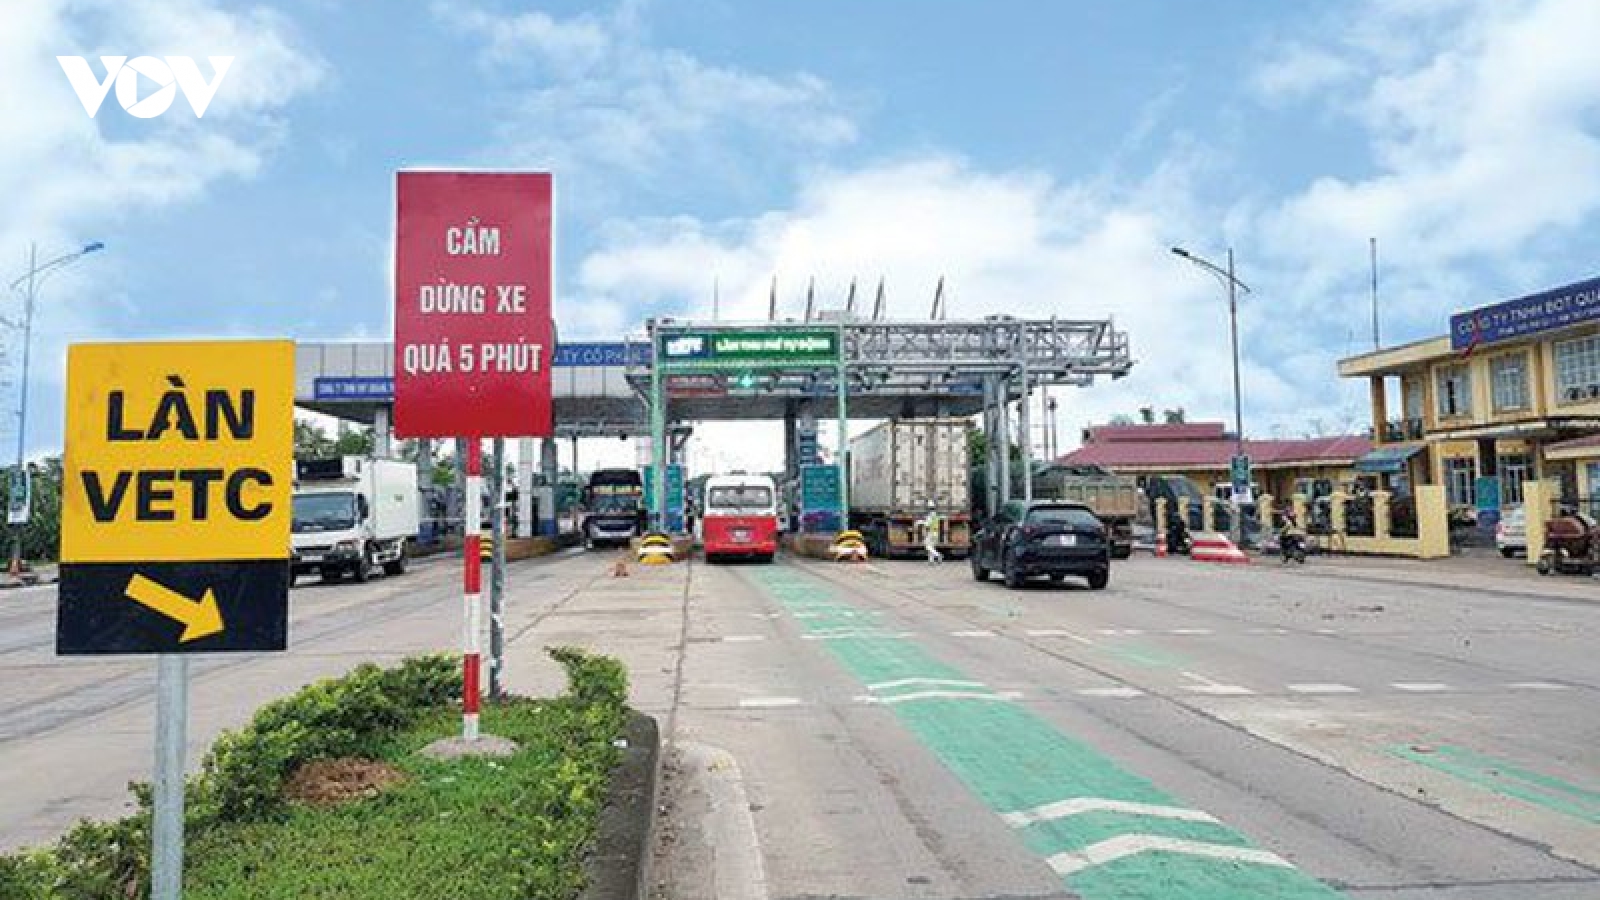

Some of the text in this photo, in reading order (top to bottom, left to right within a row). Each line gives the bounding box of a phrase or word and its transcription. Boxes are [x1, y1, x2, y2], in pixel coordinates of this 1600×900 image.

[420, 274, 527, 313] DỪNG XE
[404, 338, 542, 376] QUÁ 5 PHÚT
[106, 375, 255, 441] LÀN
[81, 467, 274, 523] VETC
